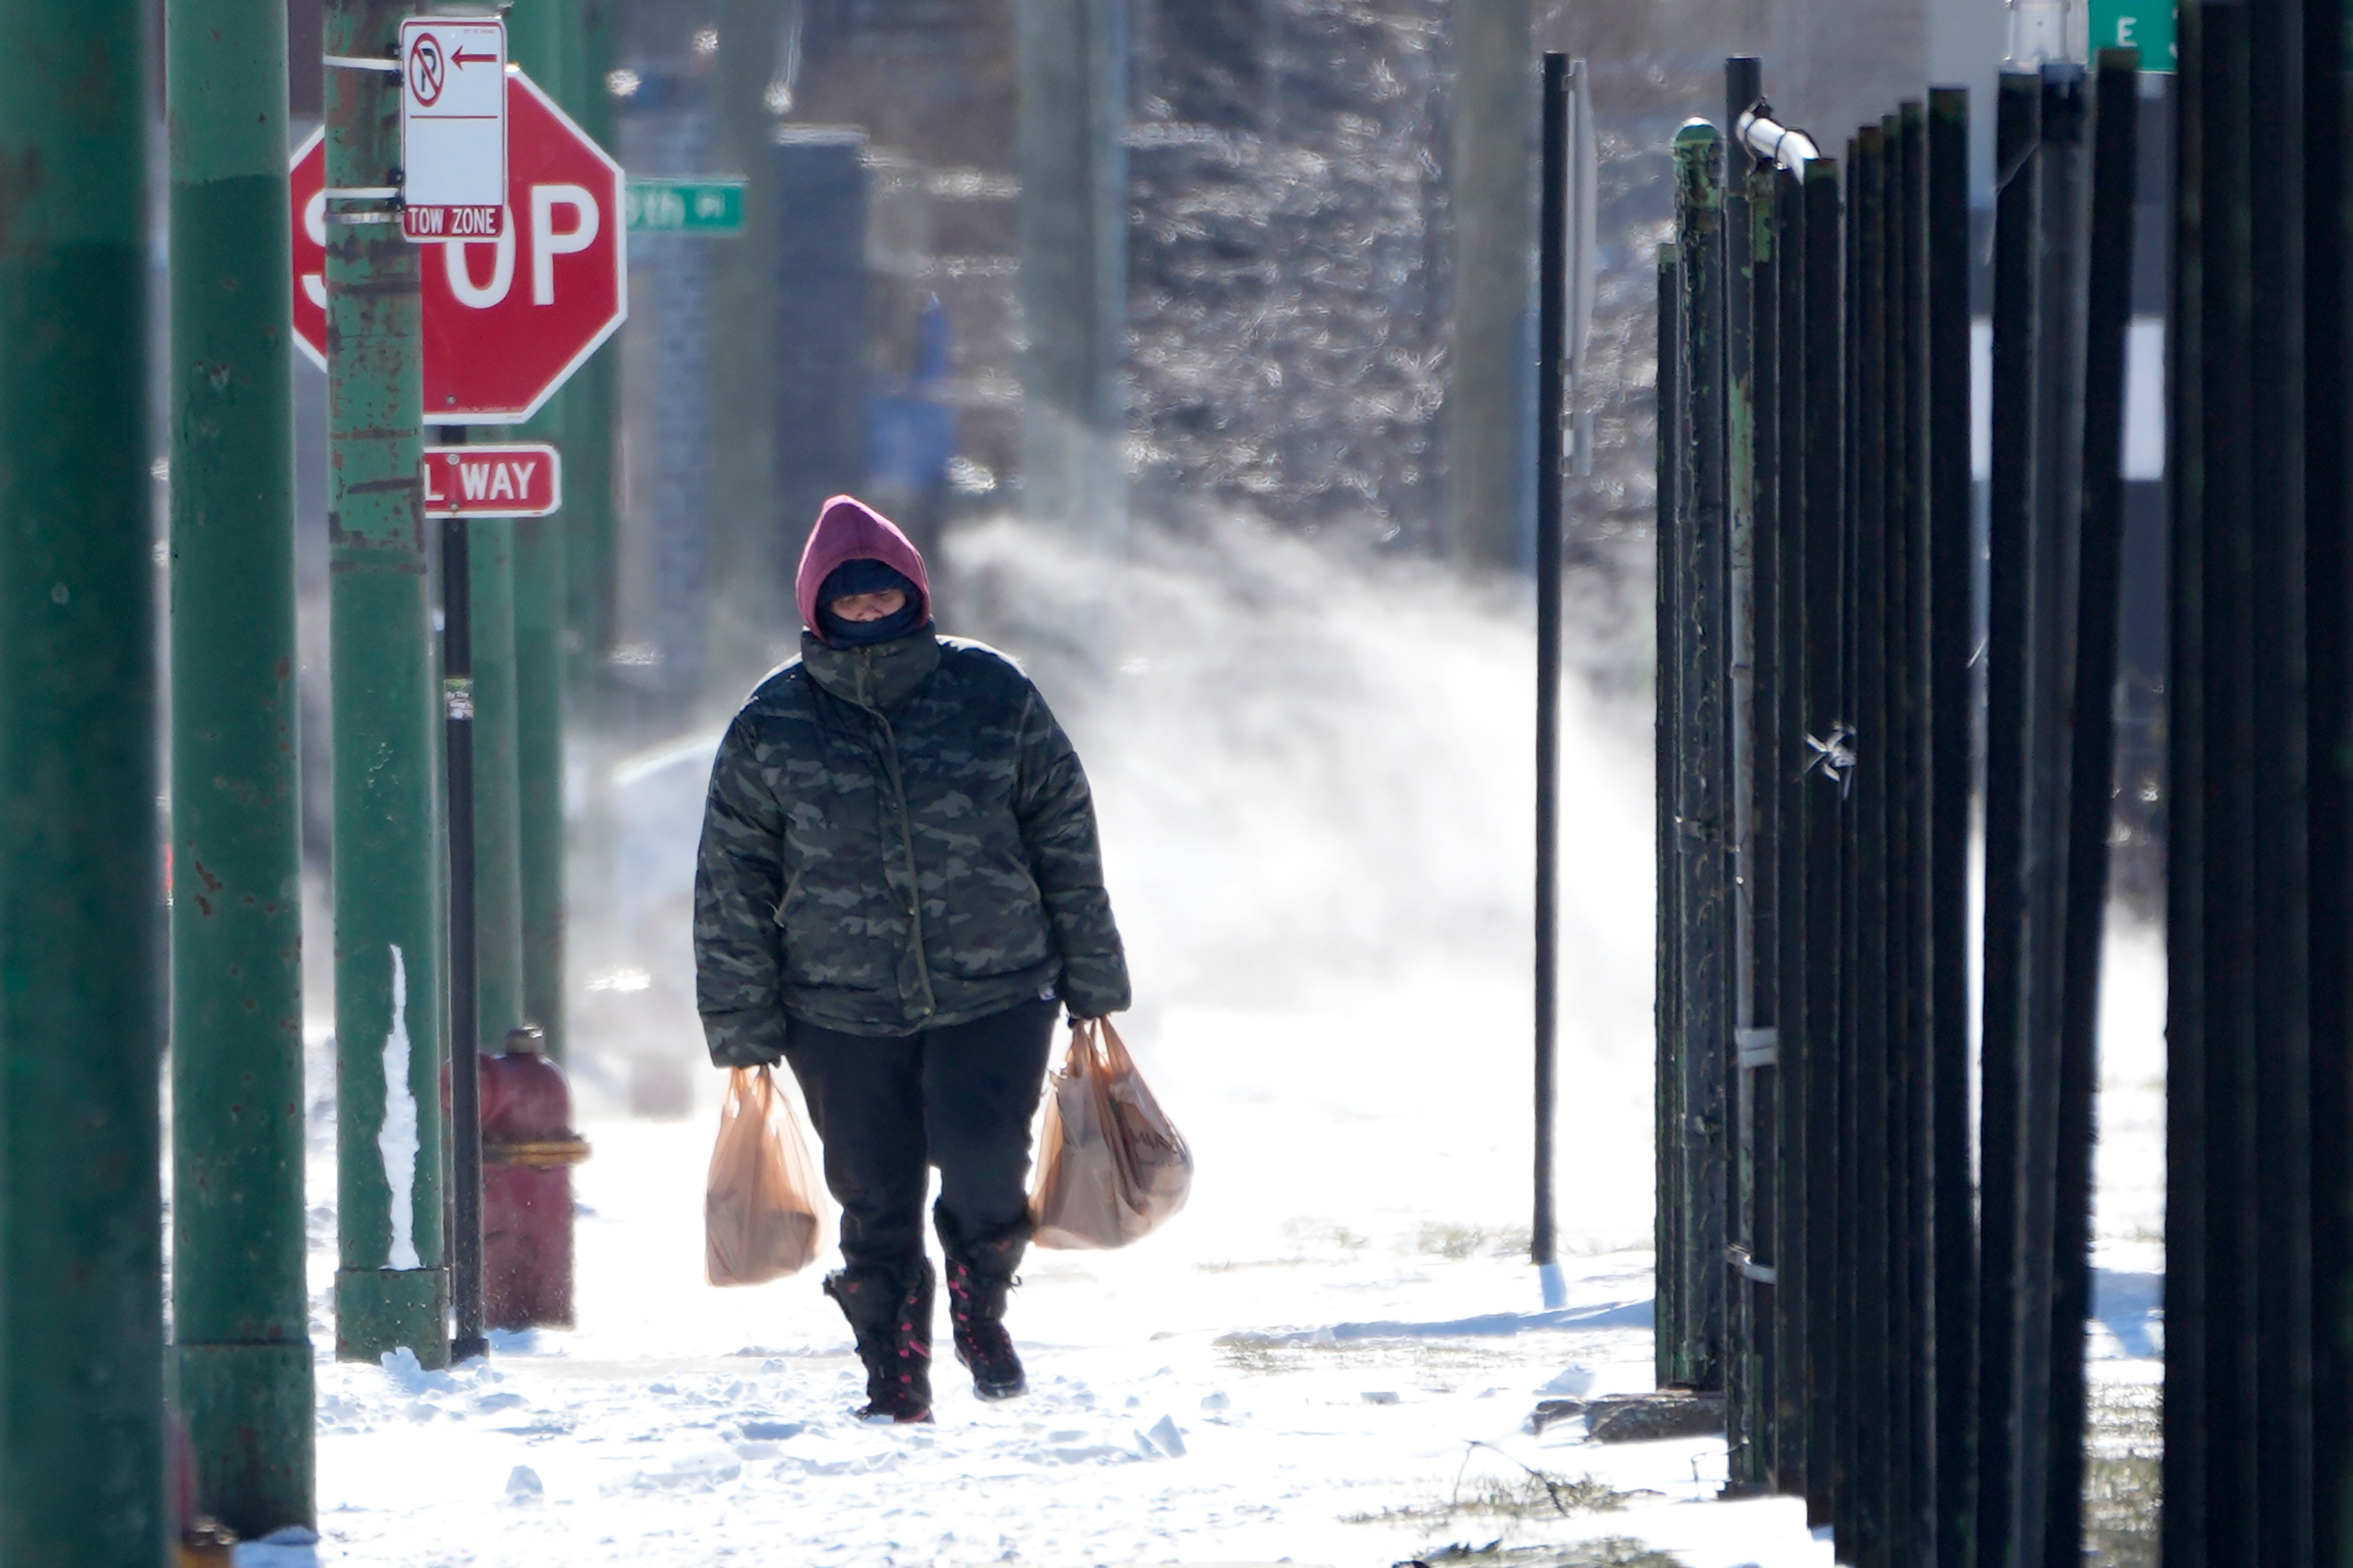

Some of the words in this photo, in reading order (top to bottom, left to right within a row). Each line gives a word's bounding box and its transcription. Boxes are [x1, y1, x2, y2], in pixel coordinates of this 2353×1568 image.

[2116, 15, 2138, 47] E
[408, 207, 444, 234] TOW
[451, 207, 496, 234] ZONE
[302, 184, 600, 310] OP
[460, 462, 536, 500] WAY
